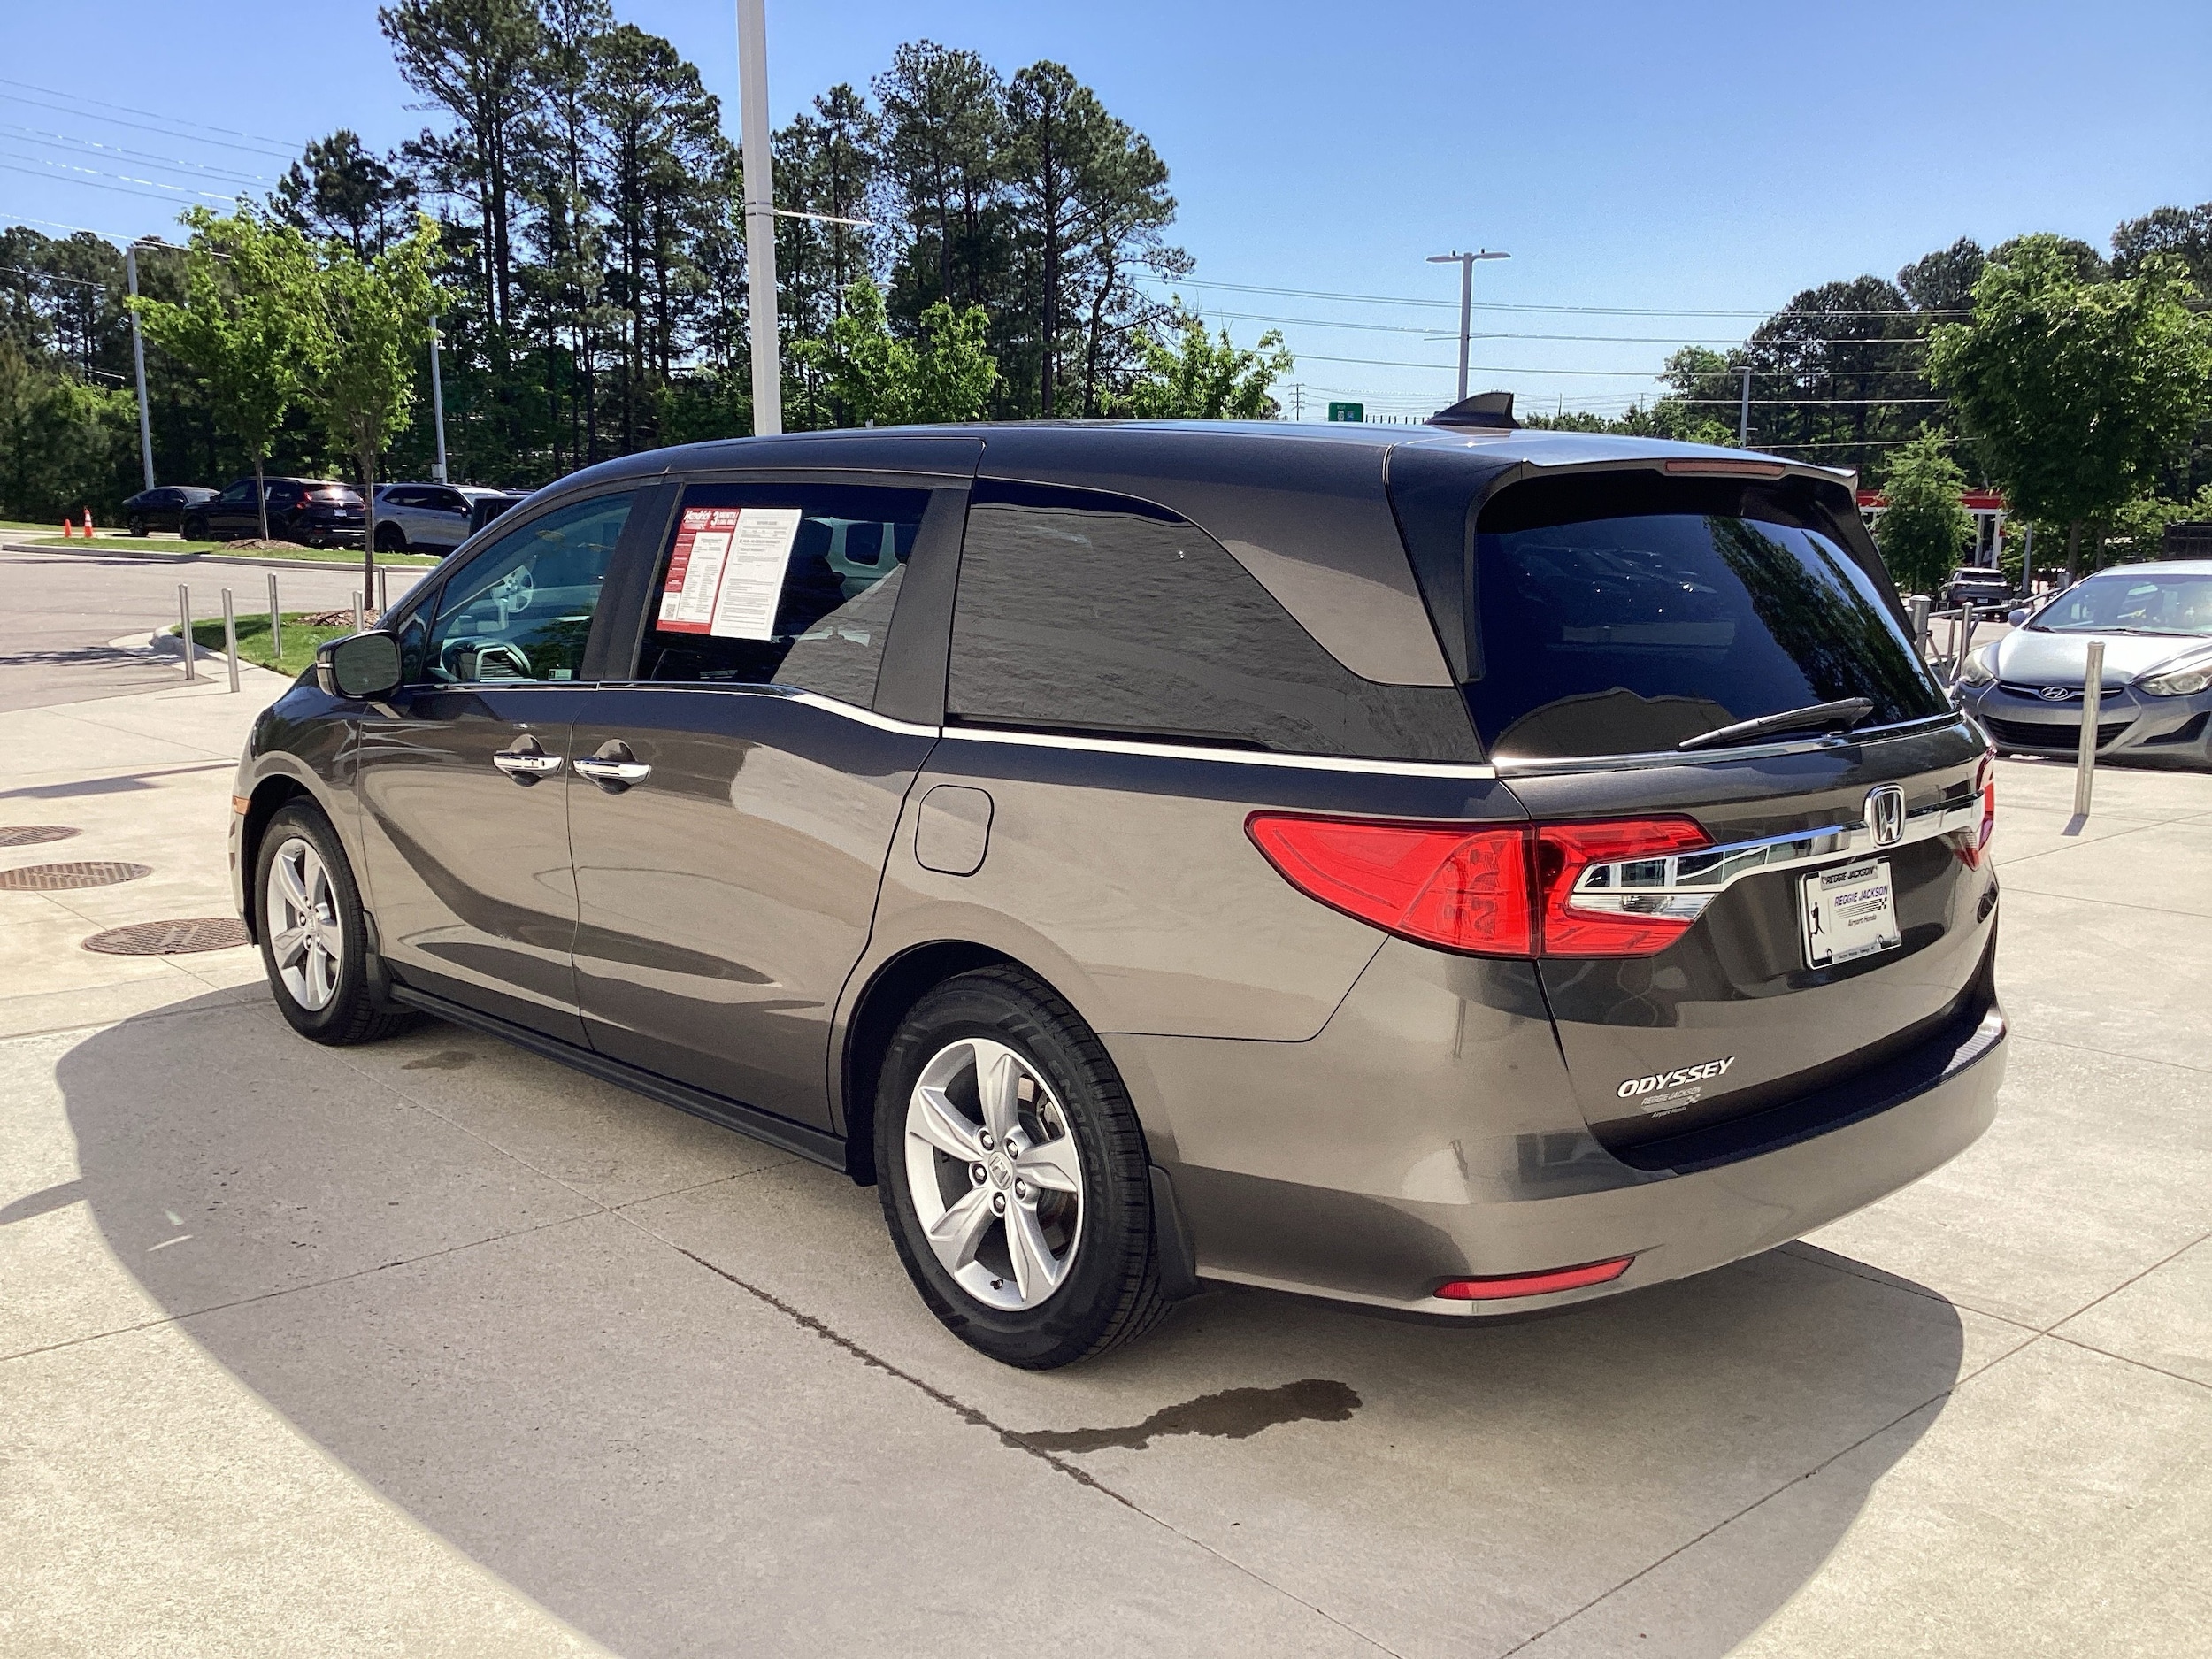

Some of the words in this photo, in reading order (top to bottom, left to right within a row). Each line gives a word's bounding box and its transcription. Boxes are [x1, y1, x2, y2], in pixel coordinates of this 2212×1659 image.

[710, 511, 719, 526] 3
[1825, 872, 1847, 885] REGGIE
[1847, 866, 1874, 879] JACKSON
[1834, 892, 1858, 908] REGGIE
[1859, 885, 1888, 902] JACKSON
[1617, 1056, 1736, 1099] ODYSSEY
[1640, 1093, 1670, 1106] REGGIE
[1669, 1086, 1703, 1101] JACKSON
